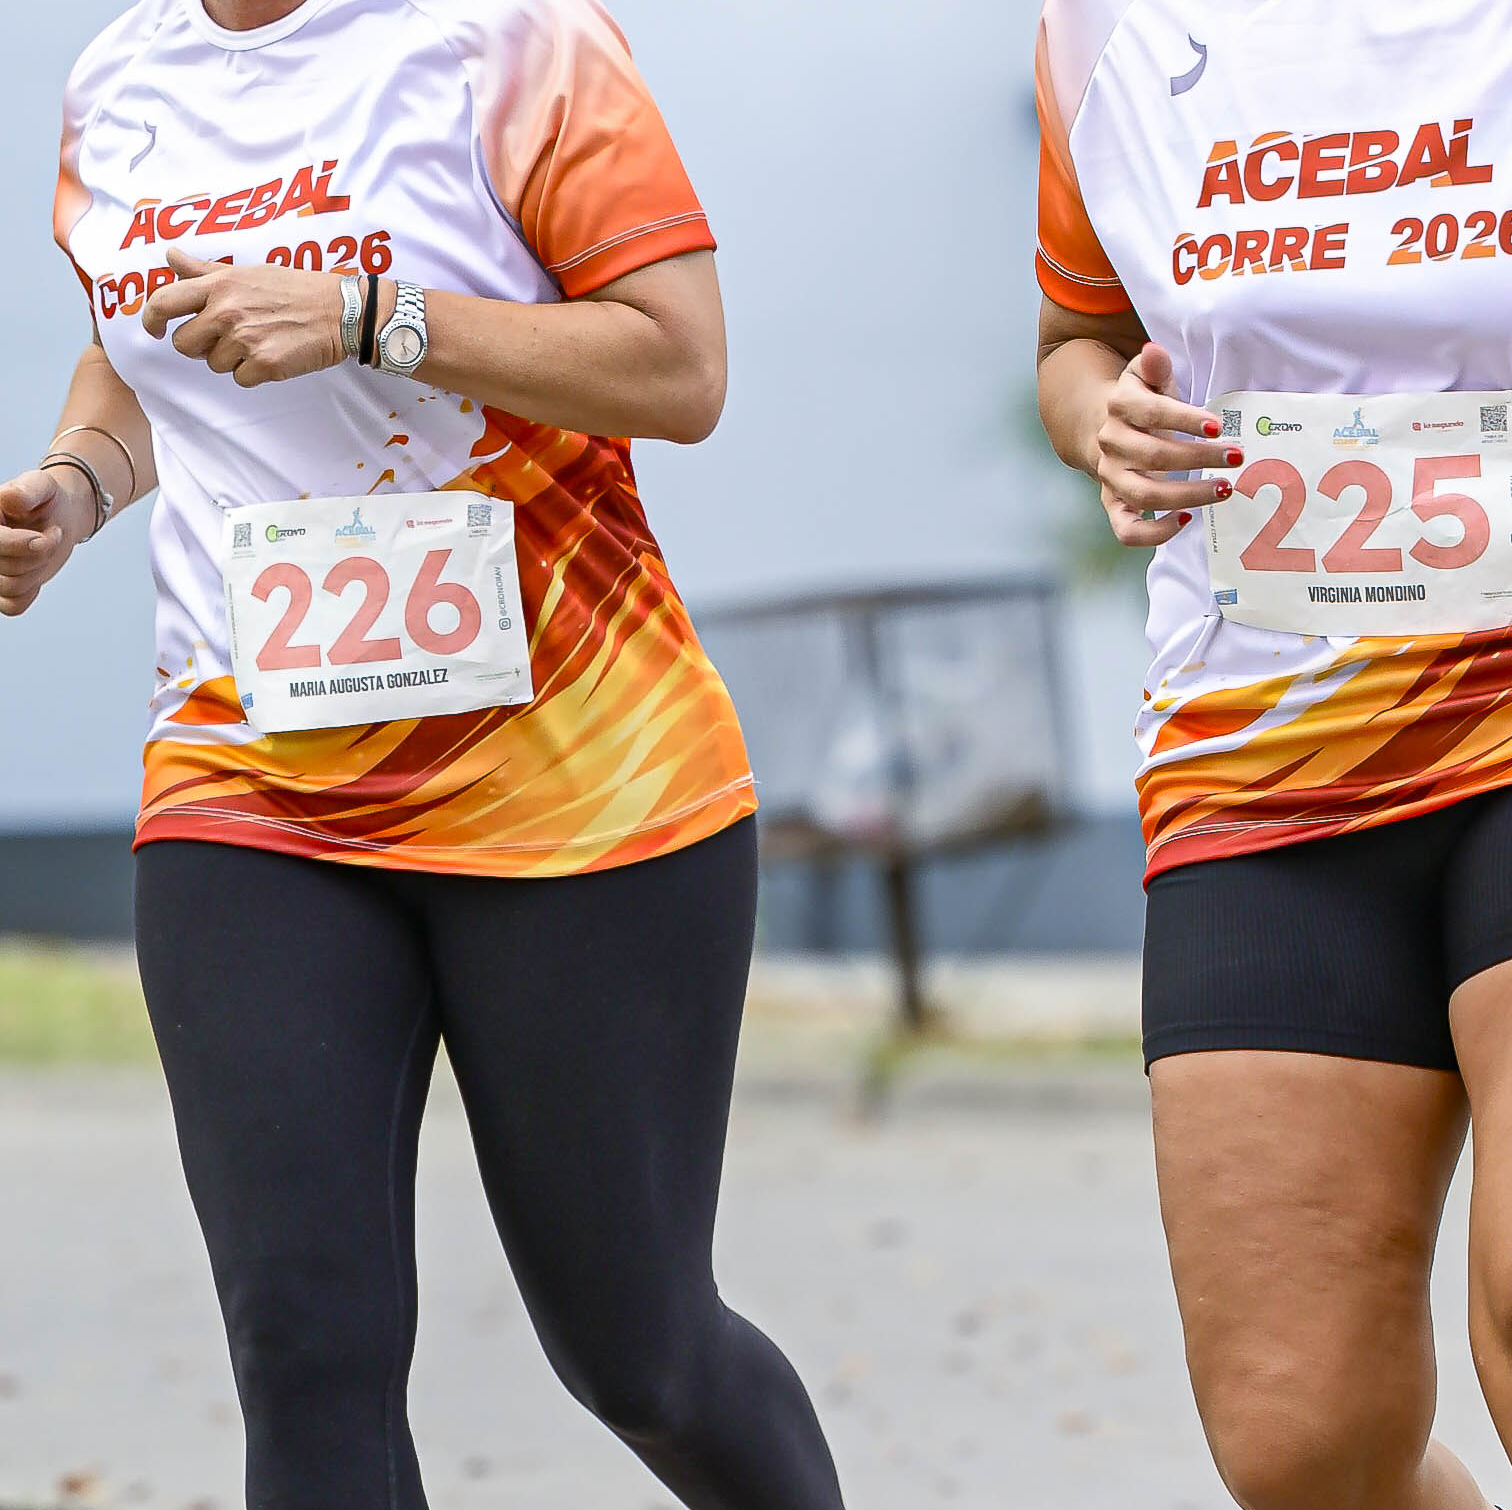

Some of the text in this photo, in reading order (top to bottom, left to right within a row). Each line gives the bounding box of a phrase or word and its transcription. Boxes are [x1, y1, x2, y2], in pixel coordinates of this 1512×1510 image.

[119, 158, 351, 251] ACEBAL
[1197, 118, 1493, 208] ACEBAL
[1173, 222, 1350, 286] CORRE
[1234, 454, 1491, 574] 225
[251, 548, 482, 672] 226
[1308, 584, 1426, 603] VIRGINIA MONDINO
[290, 668, 449, 698] MARIA AUGUSTA GONZALEZ
